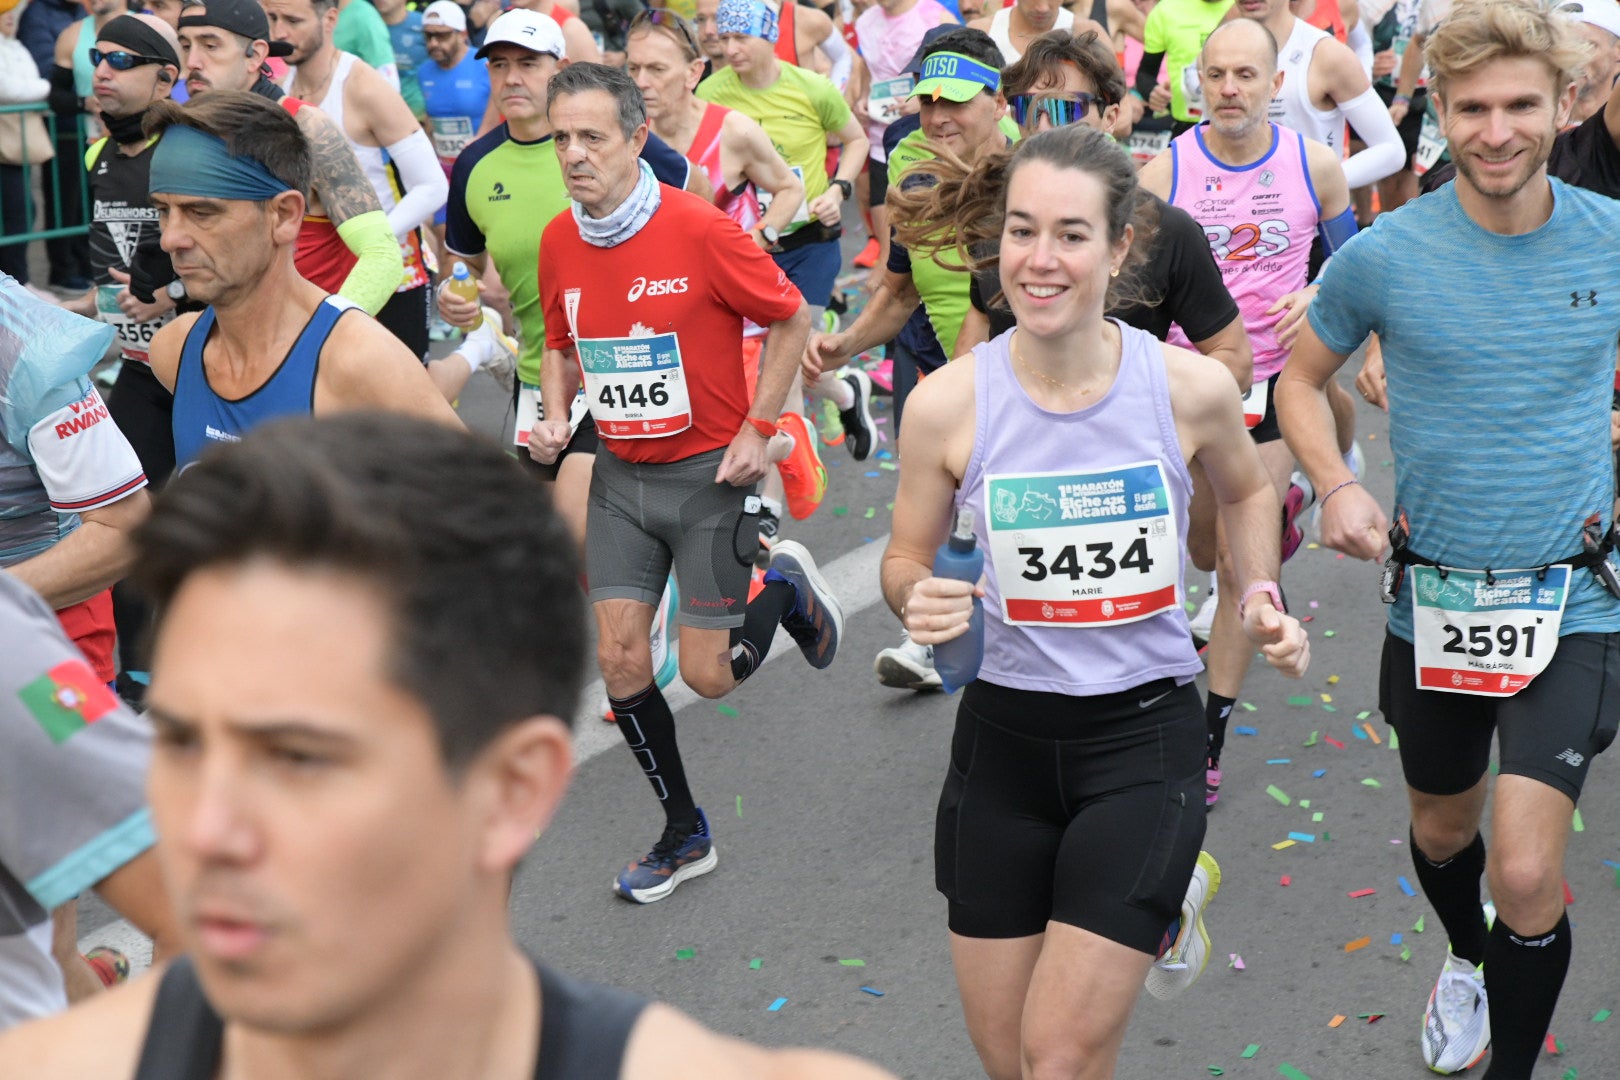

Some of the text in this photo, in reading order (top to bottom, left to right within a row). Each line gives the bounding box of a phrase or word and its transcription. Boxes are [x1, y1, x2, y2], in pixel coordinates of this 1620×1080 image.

[925, 57, 958, 77] OTSO
[1202, 219, 1290, 261] R2S
[598, 381, 669, 409] 4146
[1060, 495, 1102, 509] Elche
[1061, 503, 1127, 519] Alicante
[1018, 537, 1154, 582] 3434
[1072, 587, 1103, 596] MARIE
[1474, 588, 1511, 599] Elche
[1474, 596, 1532, 607] Alicante
[1442, 624, 1536, 658] 2591
